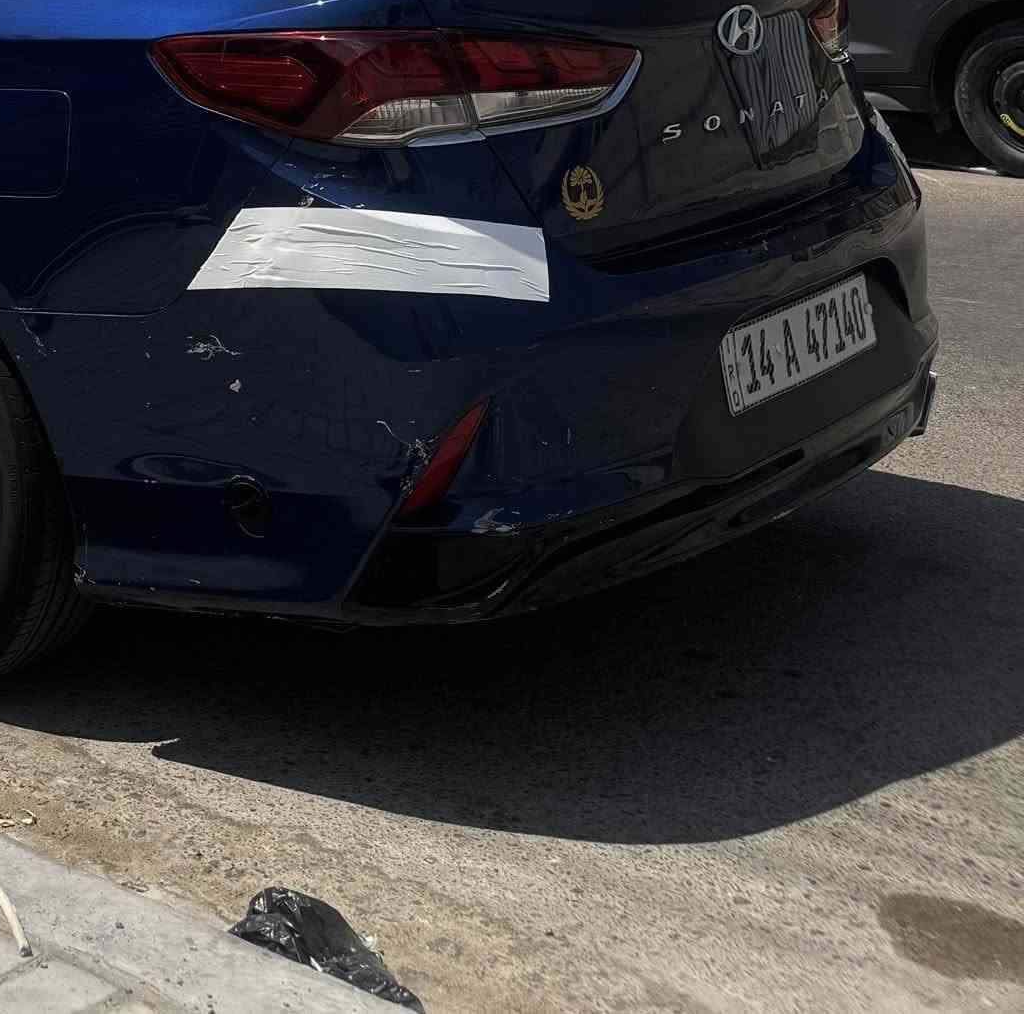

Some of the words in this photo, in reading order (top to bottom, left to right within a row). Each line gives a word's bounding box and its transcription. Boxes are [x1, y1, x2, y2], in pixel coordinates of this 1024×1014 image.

[662, 88, 829, 144] SONATA
[741, 328, 775, 394] 14
[782, 318, 801, 377] A
[805, 287, 867, 363] 47140
